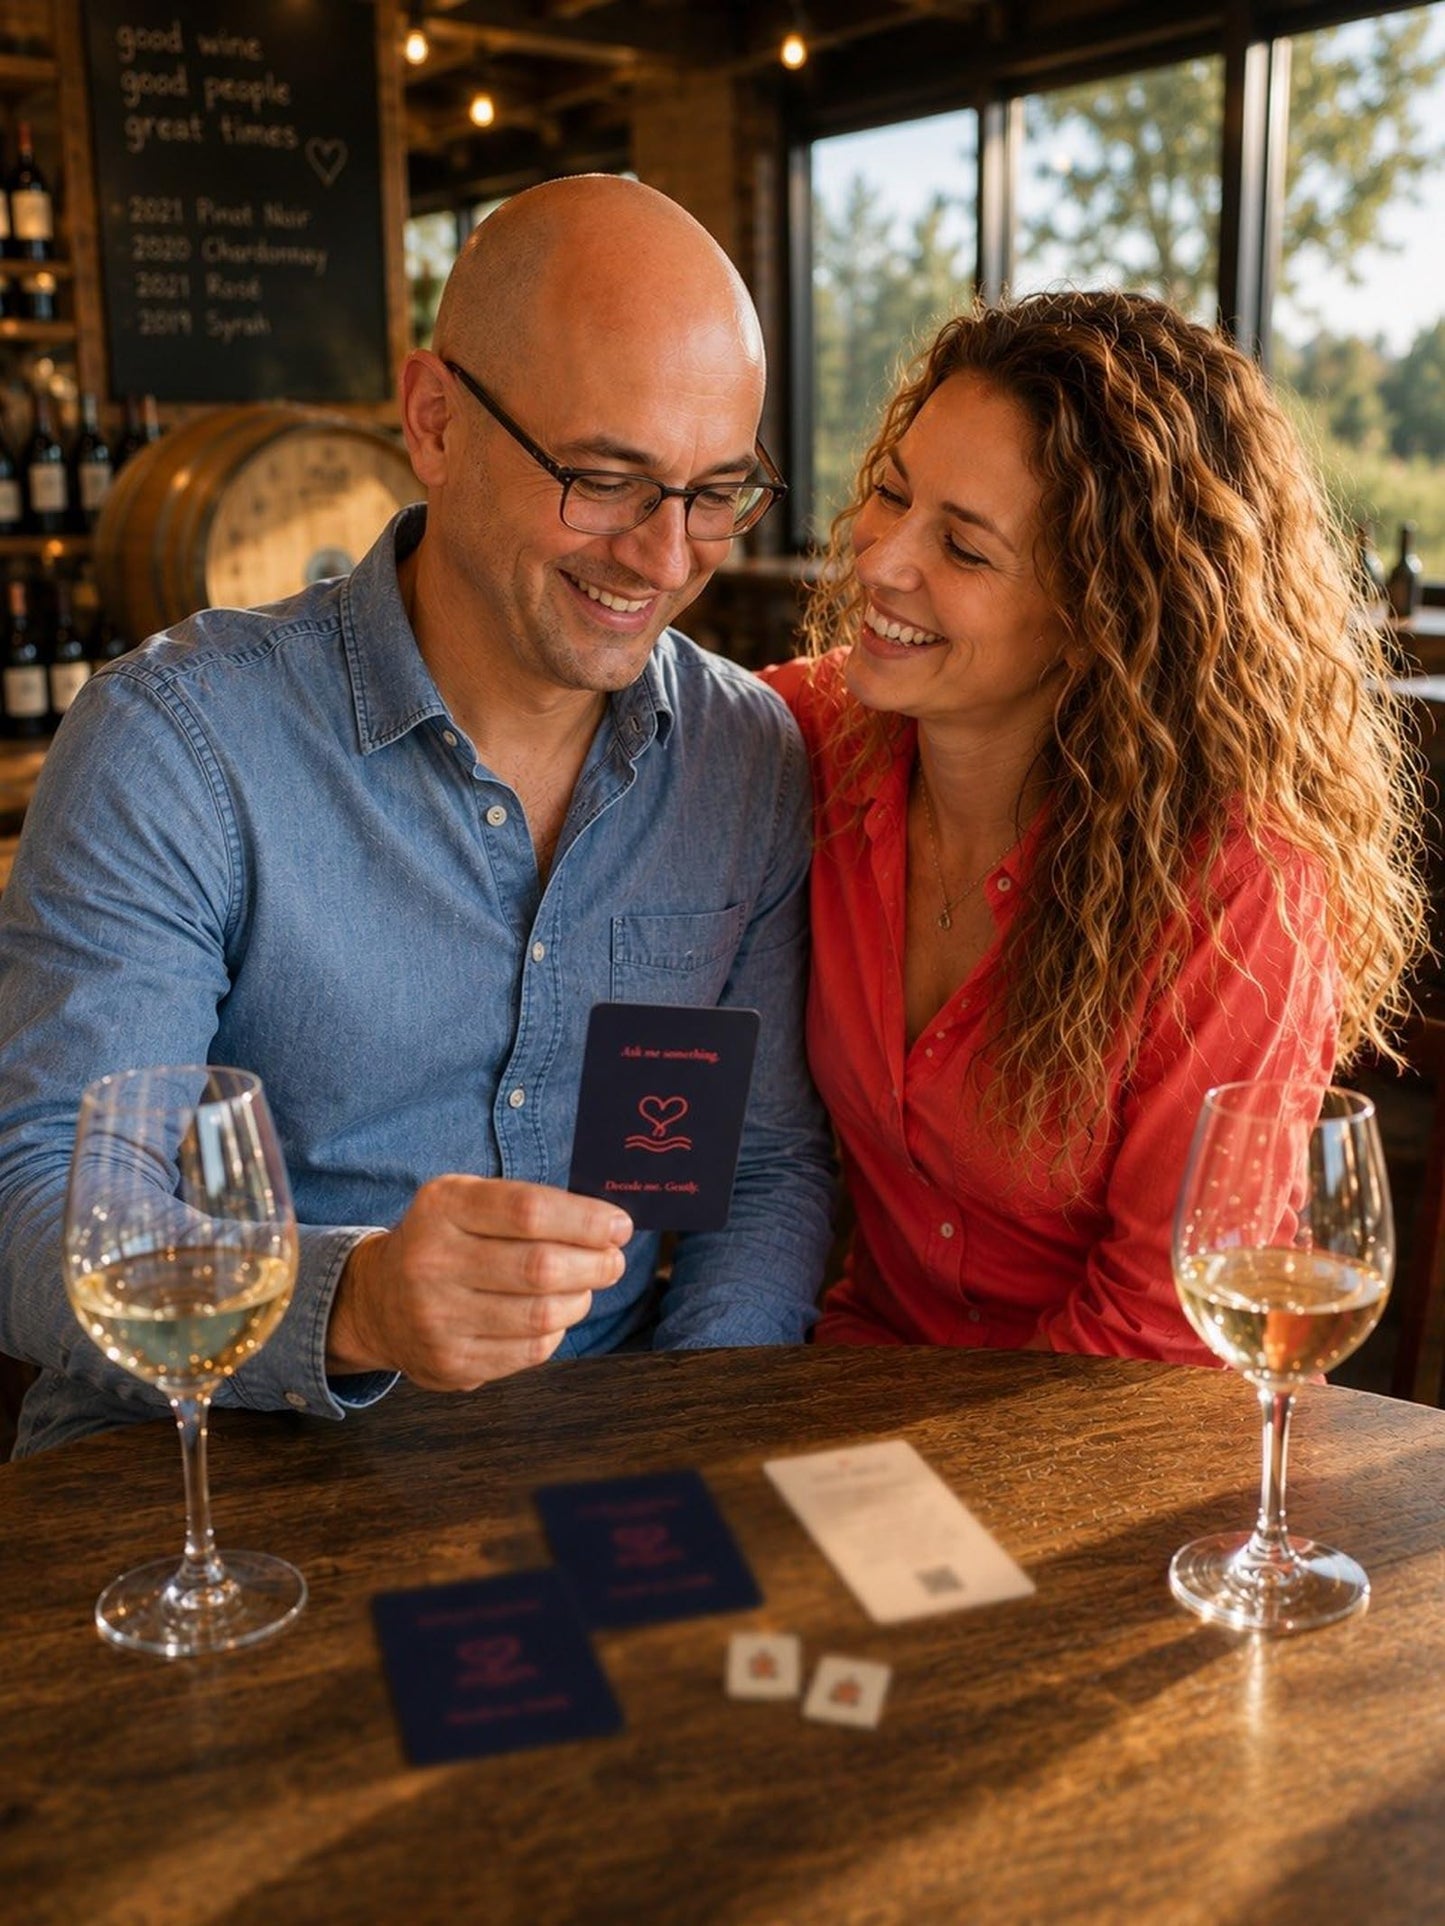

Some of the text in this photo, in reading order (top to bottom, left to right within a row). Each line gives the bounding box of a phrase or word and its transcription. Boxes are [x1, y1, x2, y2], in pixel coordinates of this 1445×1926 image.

[117, 20, 263, 63] good wine
[121, 64, 290, 112] good people
[125, 114, 298, 152] great times
[129, 196, 311, 228] 2021 Pinot Noir
[132, 234, 328, 275] 2020 Chardonnay
[136, 272, 191, 299] 2021
[206, 309, 272, 344] Syrah
[621, 1046, 641, 1058] Ask
[645, 1049, 661, 1059] me
[605, 1181, 642, 1192] Decode
